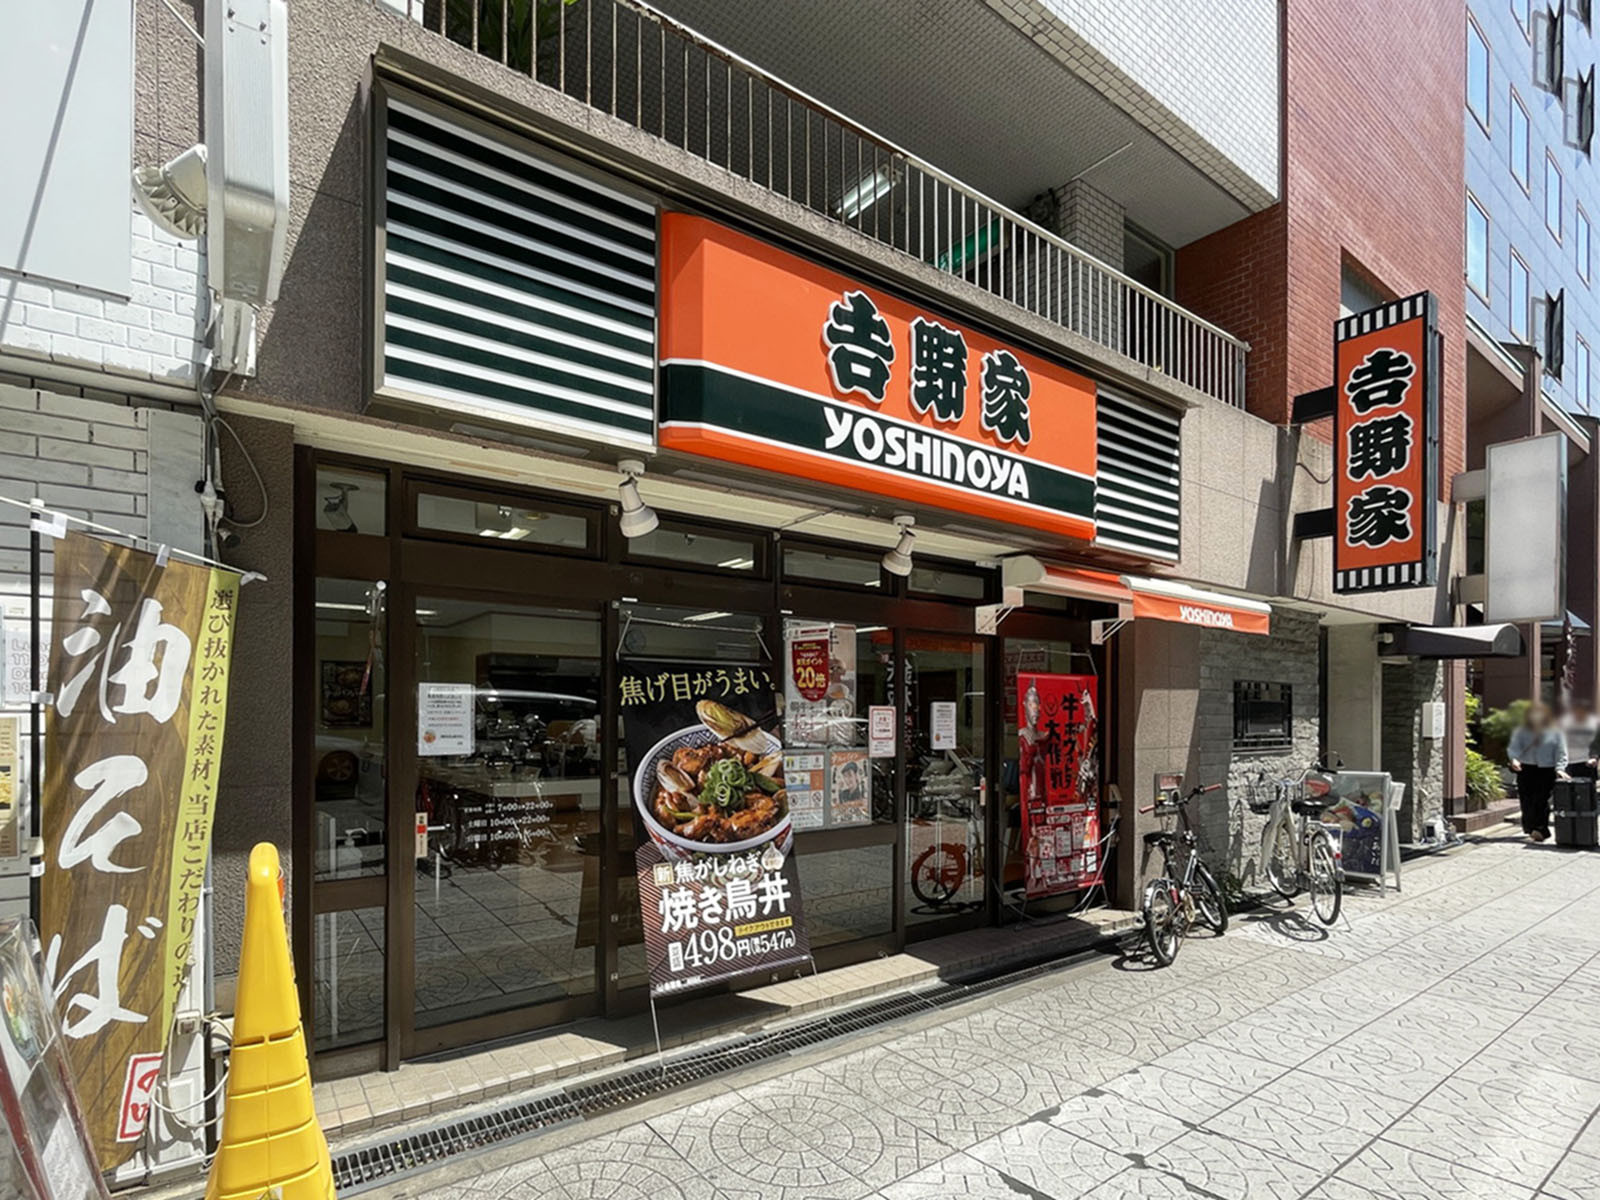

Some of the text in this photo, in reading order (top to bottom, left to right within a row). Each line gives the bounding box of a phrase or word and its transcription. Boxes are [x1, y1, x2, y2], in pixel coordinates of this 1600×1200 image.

[822, 290, 1032, 447] 吉野家
[1344, 346, 1417, 550] 吉野家
[618, 667, 776, 707] 焦げ目がうまい。
[43, 588, 192, 1039] 油そば
[674, 850, 762, 885] 焦がしねぎ
[658, 871, 792, 934] 焼き鳥丼
